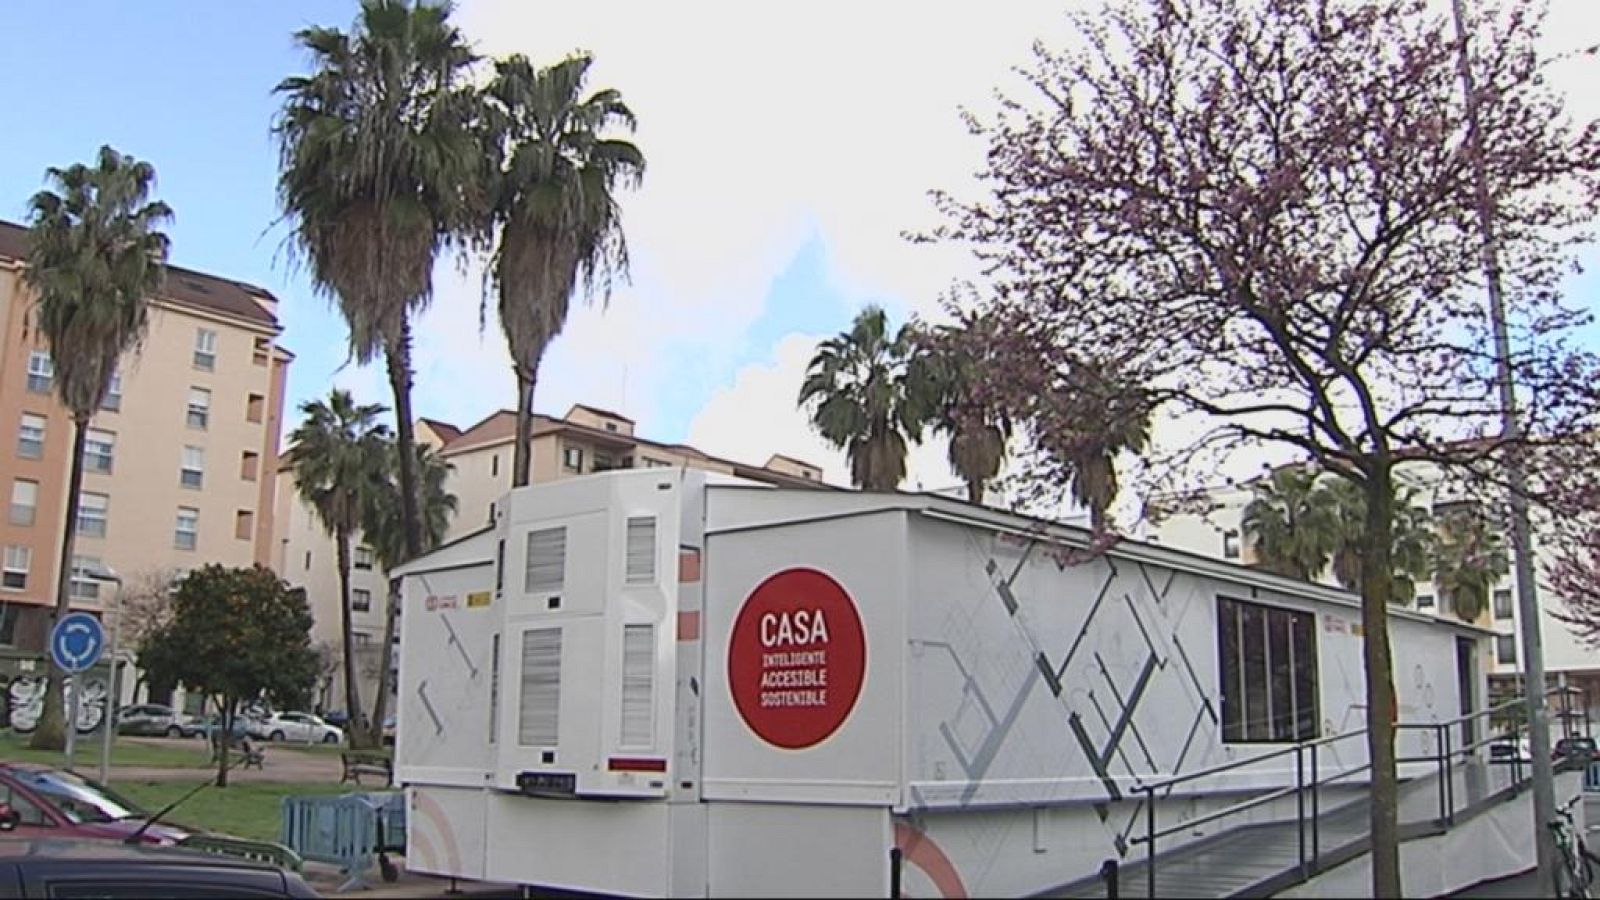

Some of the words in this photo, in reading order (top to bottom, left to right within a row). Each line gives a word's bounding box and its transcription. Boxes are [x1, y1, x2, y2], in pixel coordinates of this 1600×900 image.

[761, 610, 828, 646] CASA
[763, 651, 826, 667] INTELIGENTE
[761, 669, 827, 687] ACCESIBLE
[761, 689, 826, 707] SOSTENIBLE
